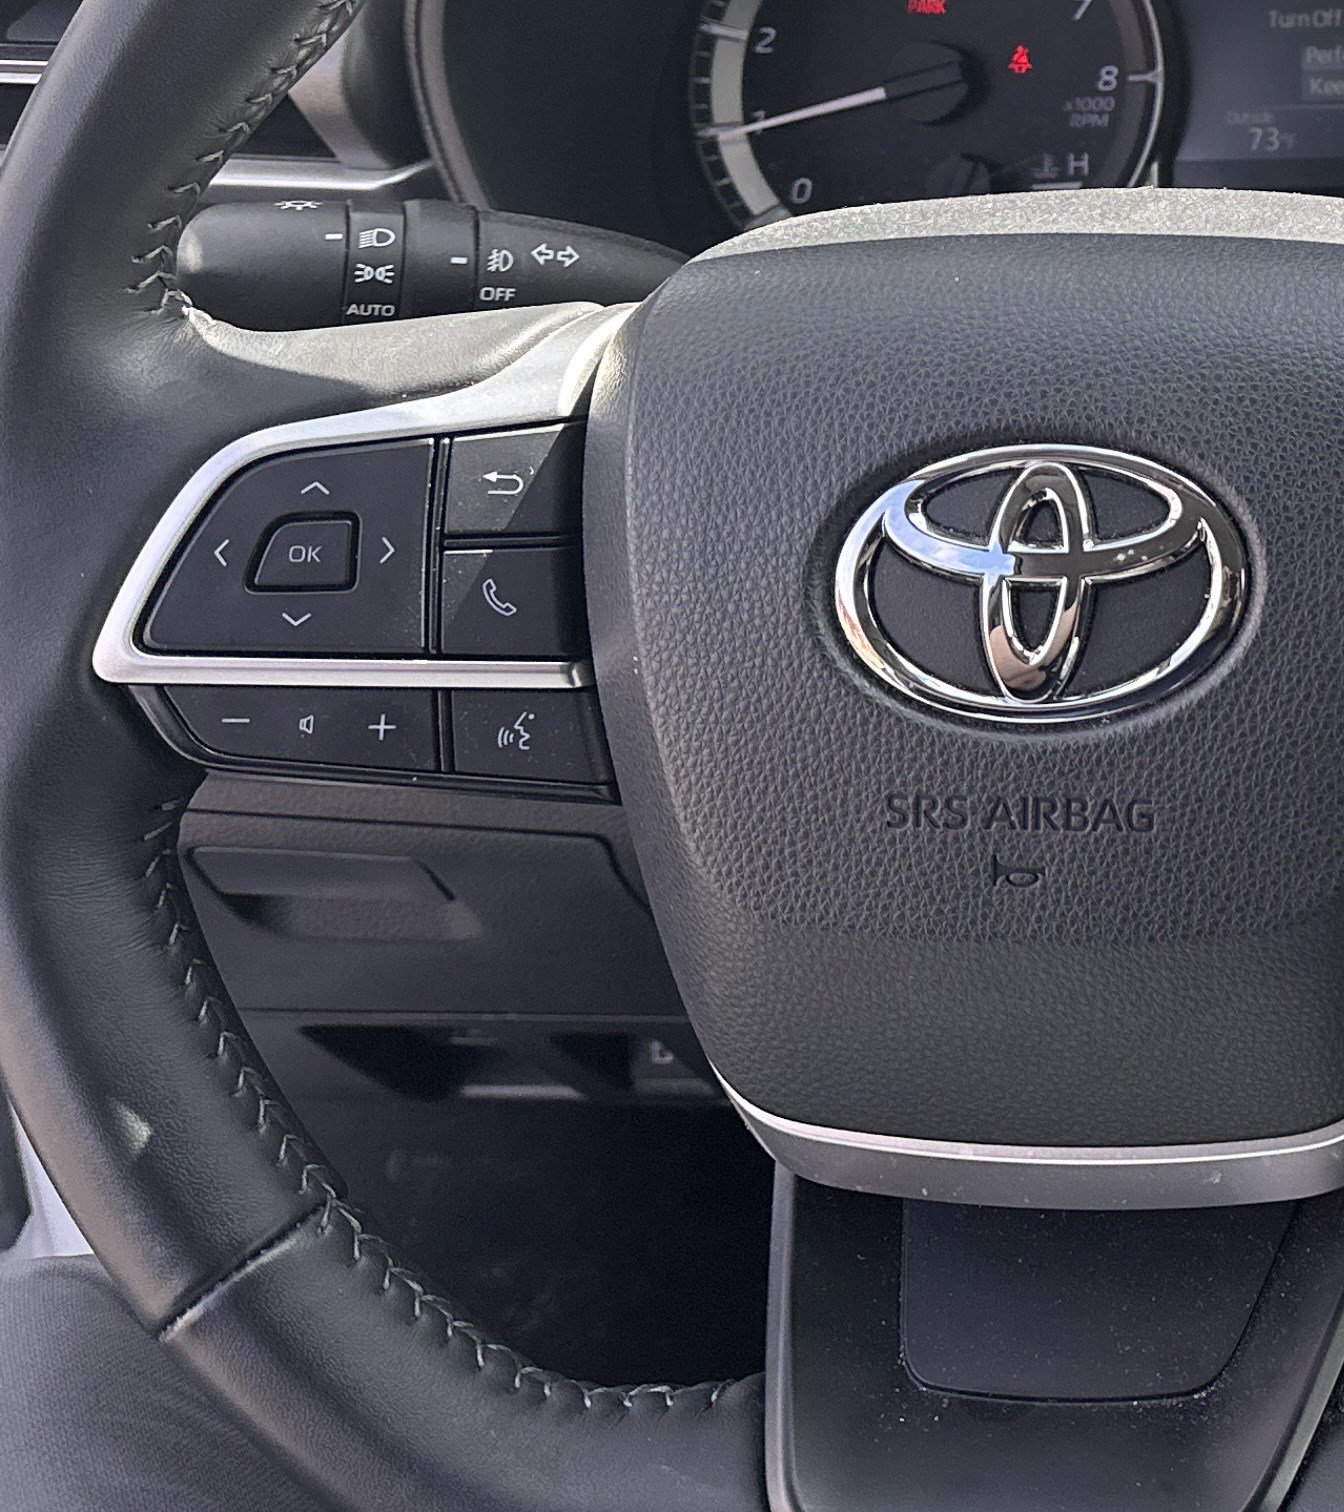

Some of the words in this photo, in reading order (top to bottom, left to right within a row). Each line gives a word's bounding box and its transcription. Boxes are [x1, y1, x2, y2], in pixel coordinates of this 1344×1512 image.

[1268, 9, 1311, 29] Turn
[1311, 8, 1342, 28] Off
[753, 27, 777, 54] 2
[1097, 65, 1120, 90] 8
[1070, 112, 1110, 128] RPM
[1067, 152, 1090, 176] H
[790, 178, 813, 204] 0
[478, 287, 517, 303] OFF
[347, 302, 396, 318] AUTO
[288, 545, 322, 564] OK
[884, 794, 970, 831] SRS
[983, 795, 1158, 834] AIRBAG
